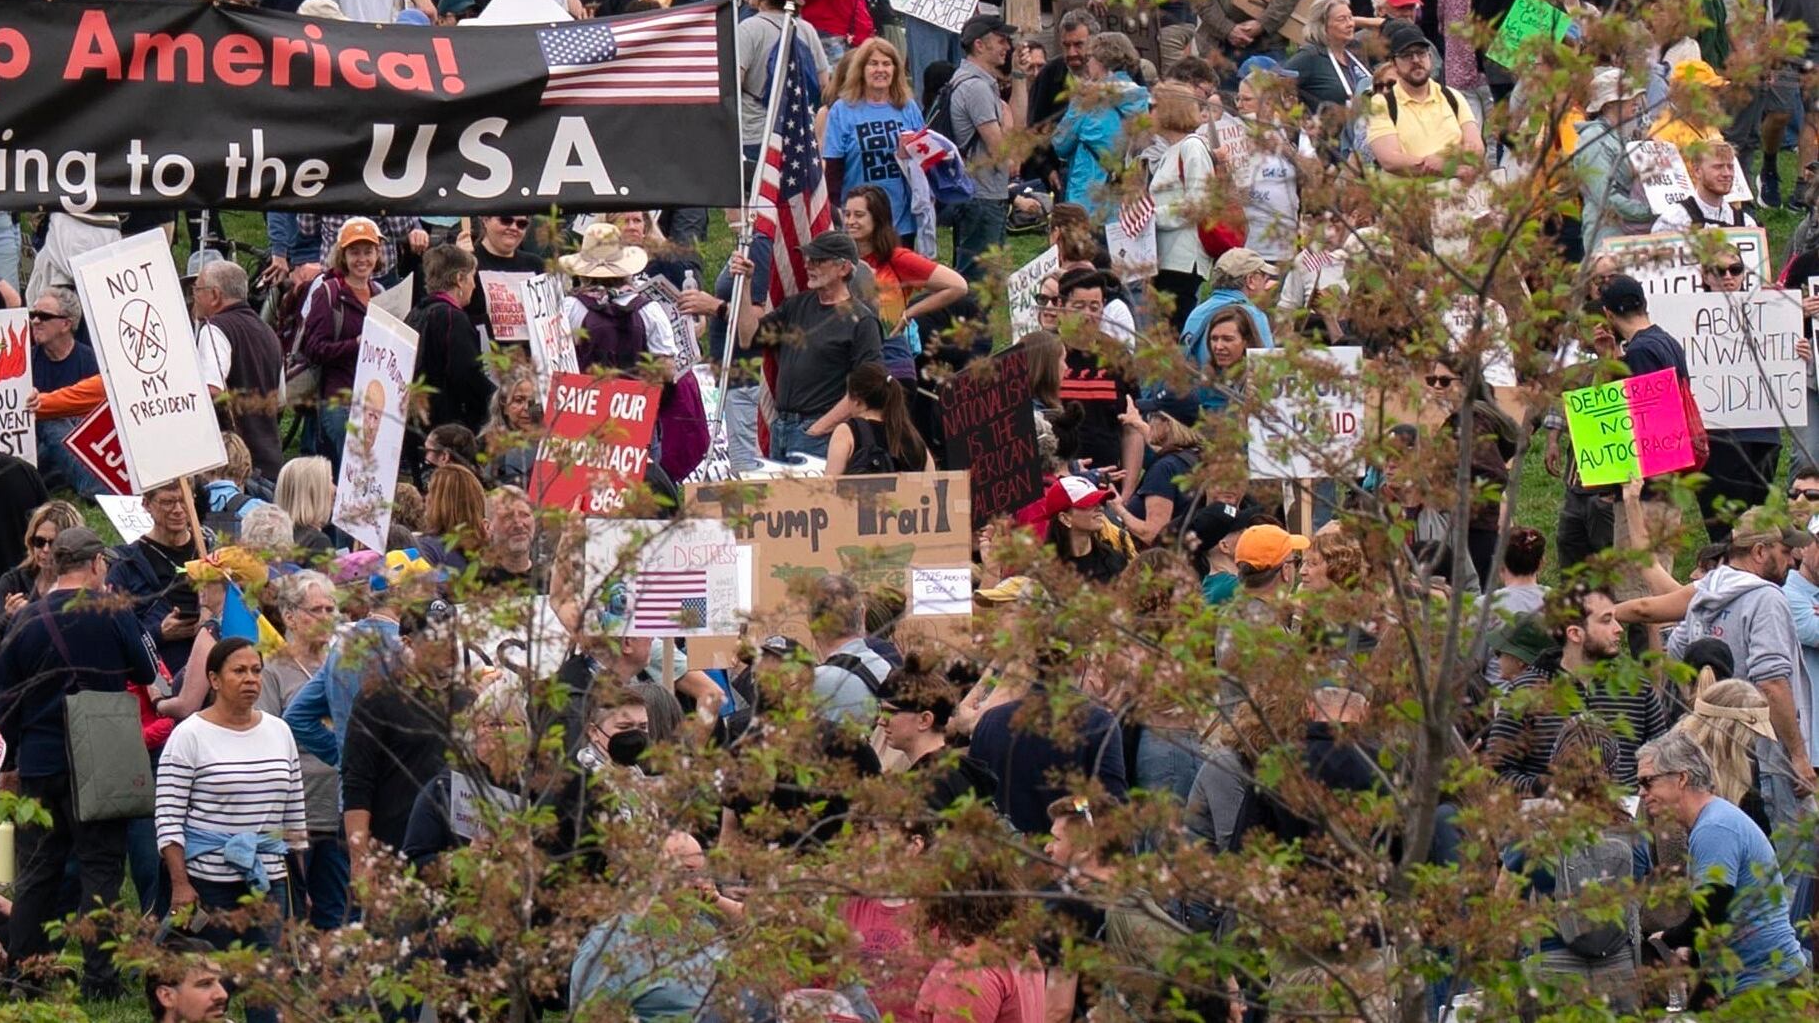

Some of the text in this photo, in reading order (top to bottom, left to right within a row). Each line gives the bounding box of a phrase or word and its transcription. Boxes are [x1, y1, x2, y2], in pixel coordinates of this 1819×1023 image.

[62, 9, 466, 95] America!
[126, 138, 195, 196] to
[226, 128, 330, 199] the
[363, 116, 630, 199] U.S.A.
[106, 262, 155, 299] NOT
[1696, 301, 1767, 336] ABORT
[141, 370, 170, 398] MY
[1570, 375, 1676, 414] DEMOCRACY
[129, 393, 198, 426] PRESIDENT
[556, 385, 647, 422] SAVE OUR
[942, 377, 1032, 438] NATIONALISM
[967, 415, 1016, 455] IS THE
[1600, 410, 1648, 435] NOT
[536, 438, 648, 474] DEMOCRACY
[1578, 432, 1685, 471] AUTOCRACY
[697, 477, 952, 553] Trump Trail
[673, 544, 739, 568] DISTRESS
